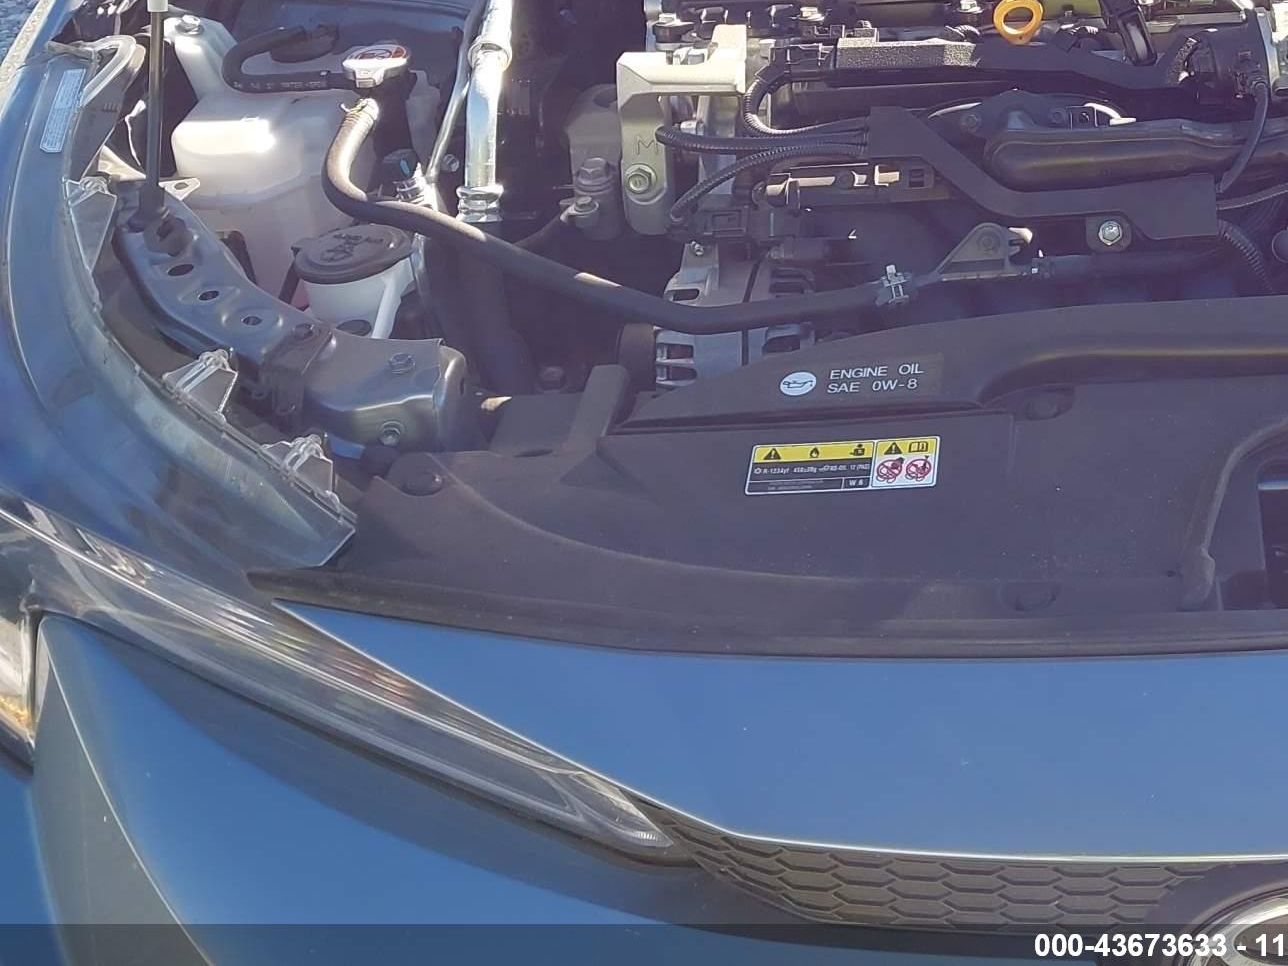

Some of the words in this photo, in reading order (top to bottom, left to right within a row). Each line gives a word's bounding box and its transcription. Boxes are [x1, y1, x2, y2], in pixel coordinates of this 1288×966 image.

[829, 365, 889, 380] ENGINE
[898, 363, 924, 375] OIL
[827, 381, 860, 394] SAE
[872, 378, 918, 392] 0W-8
